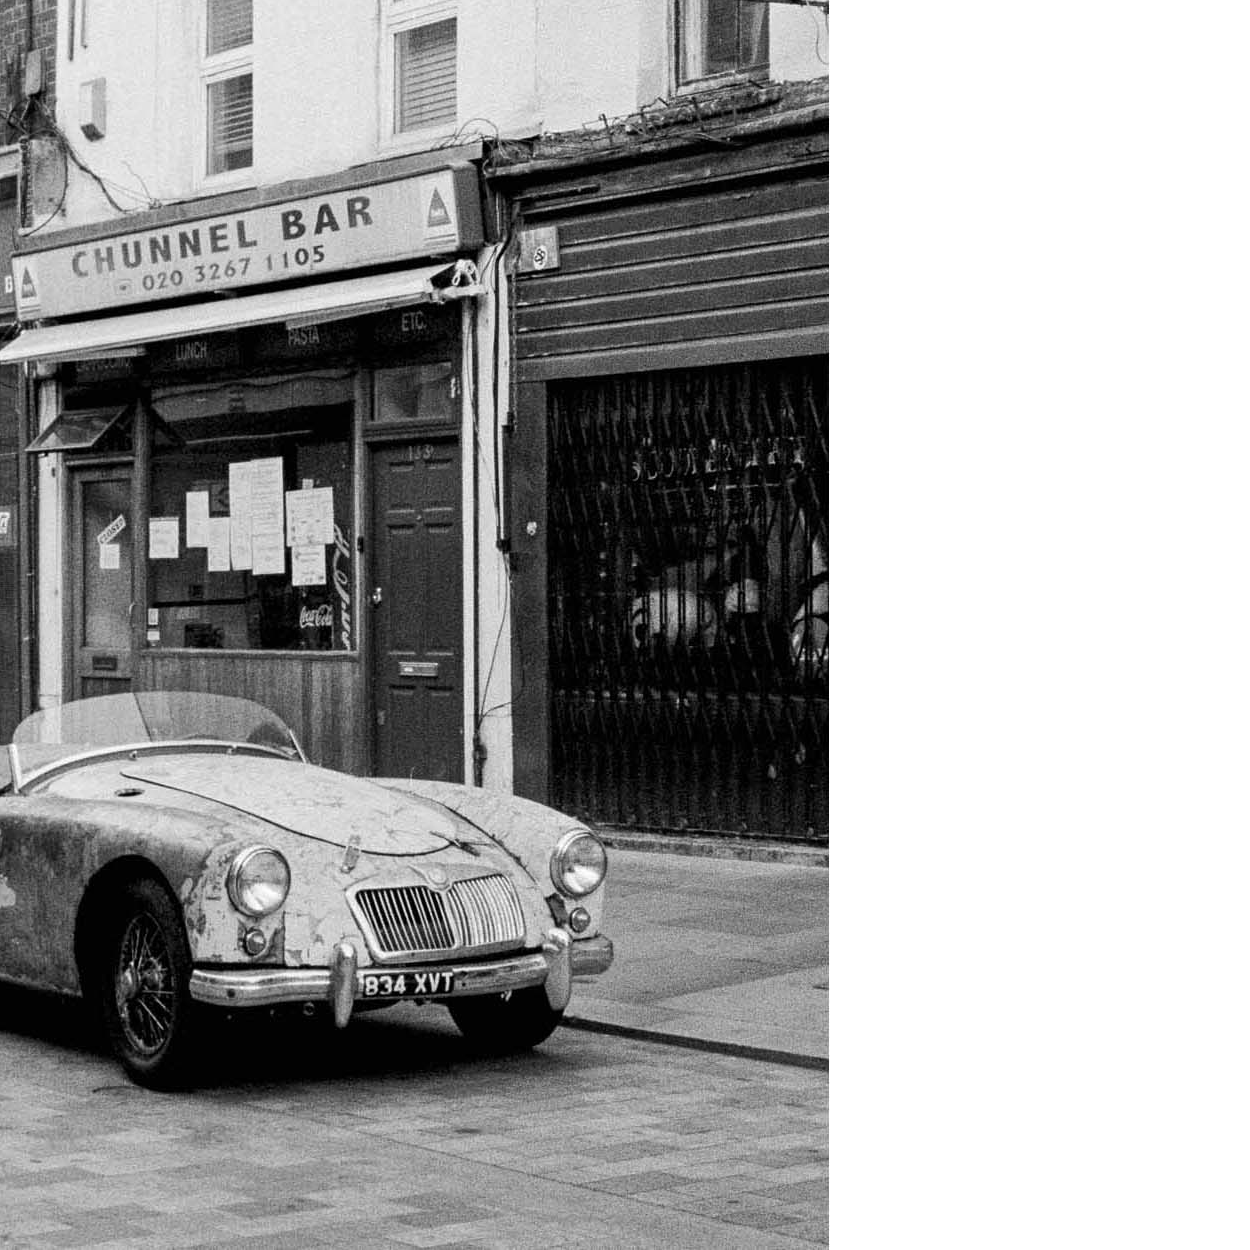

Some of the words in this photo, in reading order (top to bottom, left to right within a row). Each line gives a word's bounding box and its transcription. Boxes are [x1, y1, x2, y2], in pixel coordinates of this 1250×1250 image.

[72, 220, 258, 277] CHUNNEL
[281, 196, 373, 241] BAR
[142, 270, 183, 291] 020
[195, 258, 251, 283] 3267
[266, 244, 326, 271] 1105
[175, 341, 207, 361] LUNCH
[288, 324, 321, 347] PASTA
[414, 972, 454, 994] XVT
